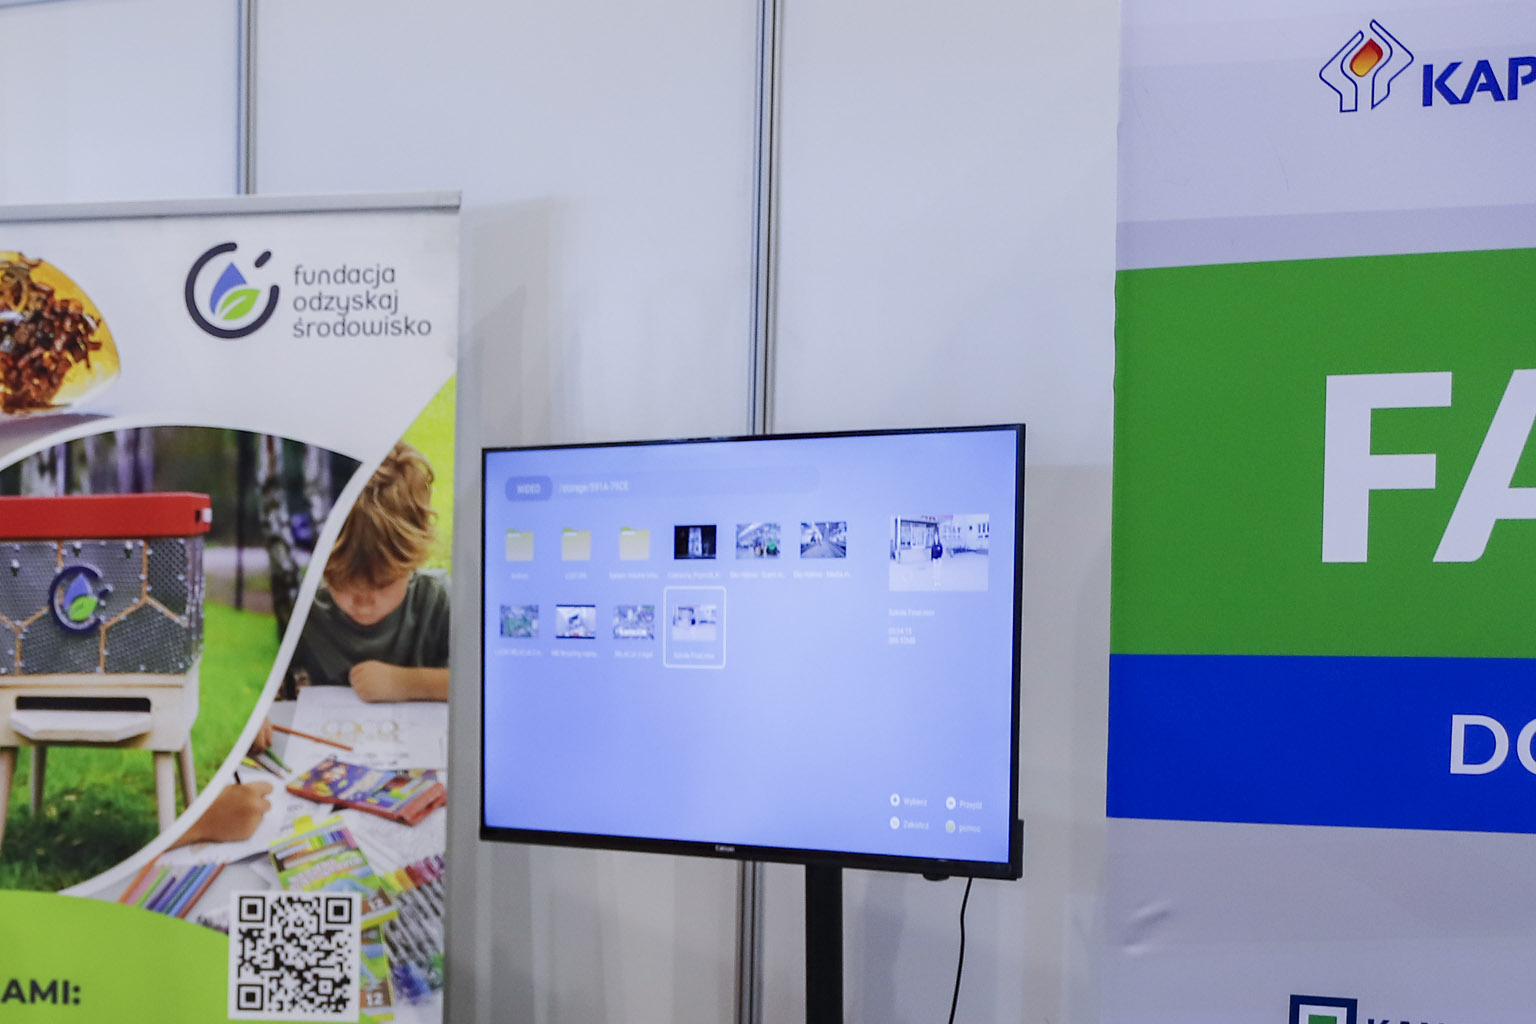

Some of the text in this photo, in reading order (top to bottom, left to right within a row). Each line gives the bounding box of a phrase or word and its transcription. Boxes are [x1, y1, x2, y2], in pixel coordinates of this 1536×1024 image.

[293, 264, 395, 289] fundacja
[293, 290, 398, 316] odzyskaj
[293, 314, 431, 338] środowisko
